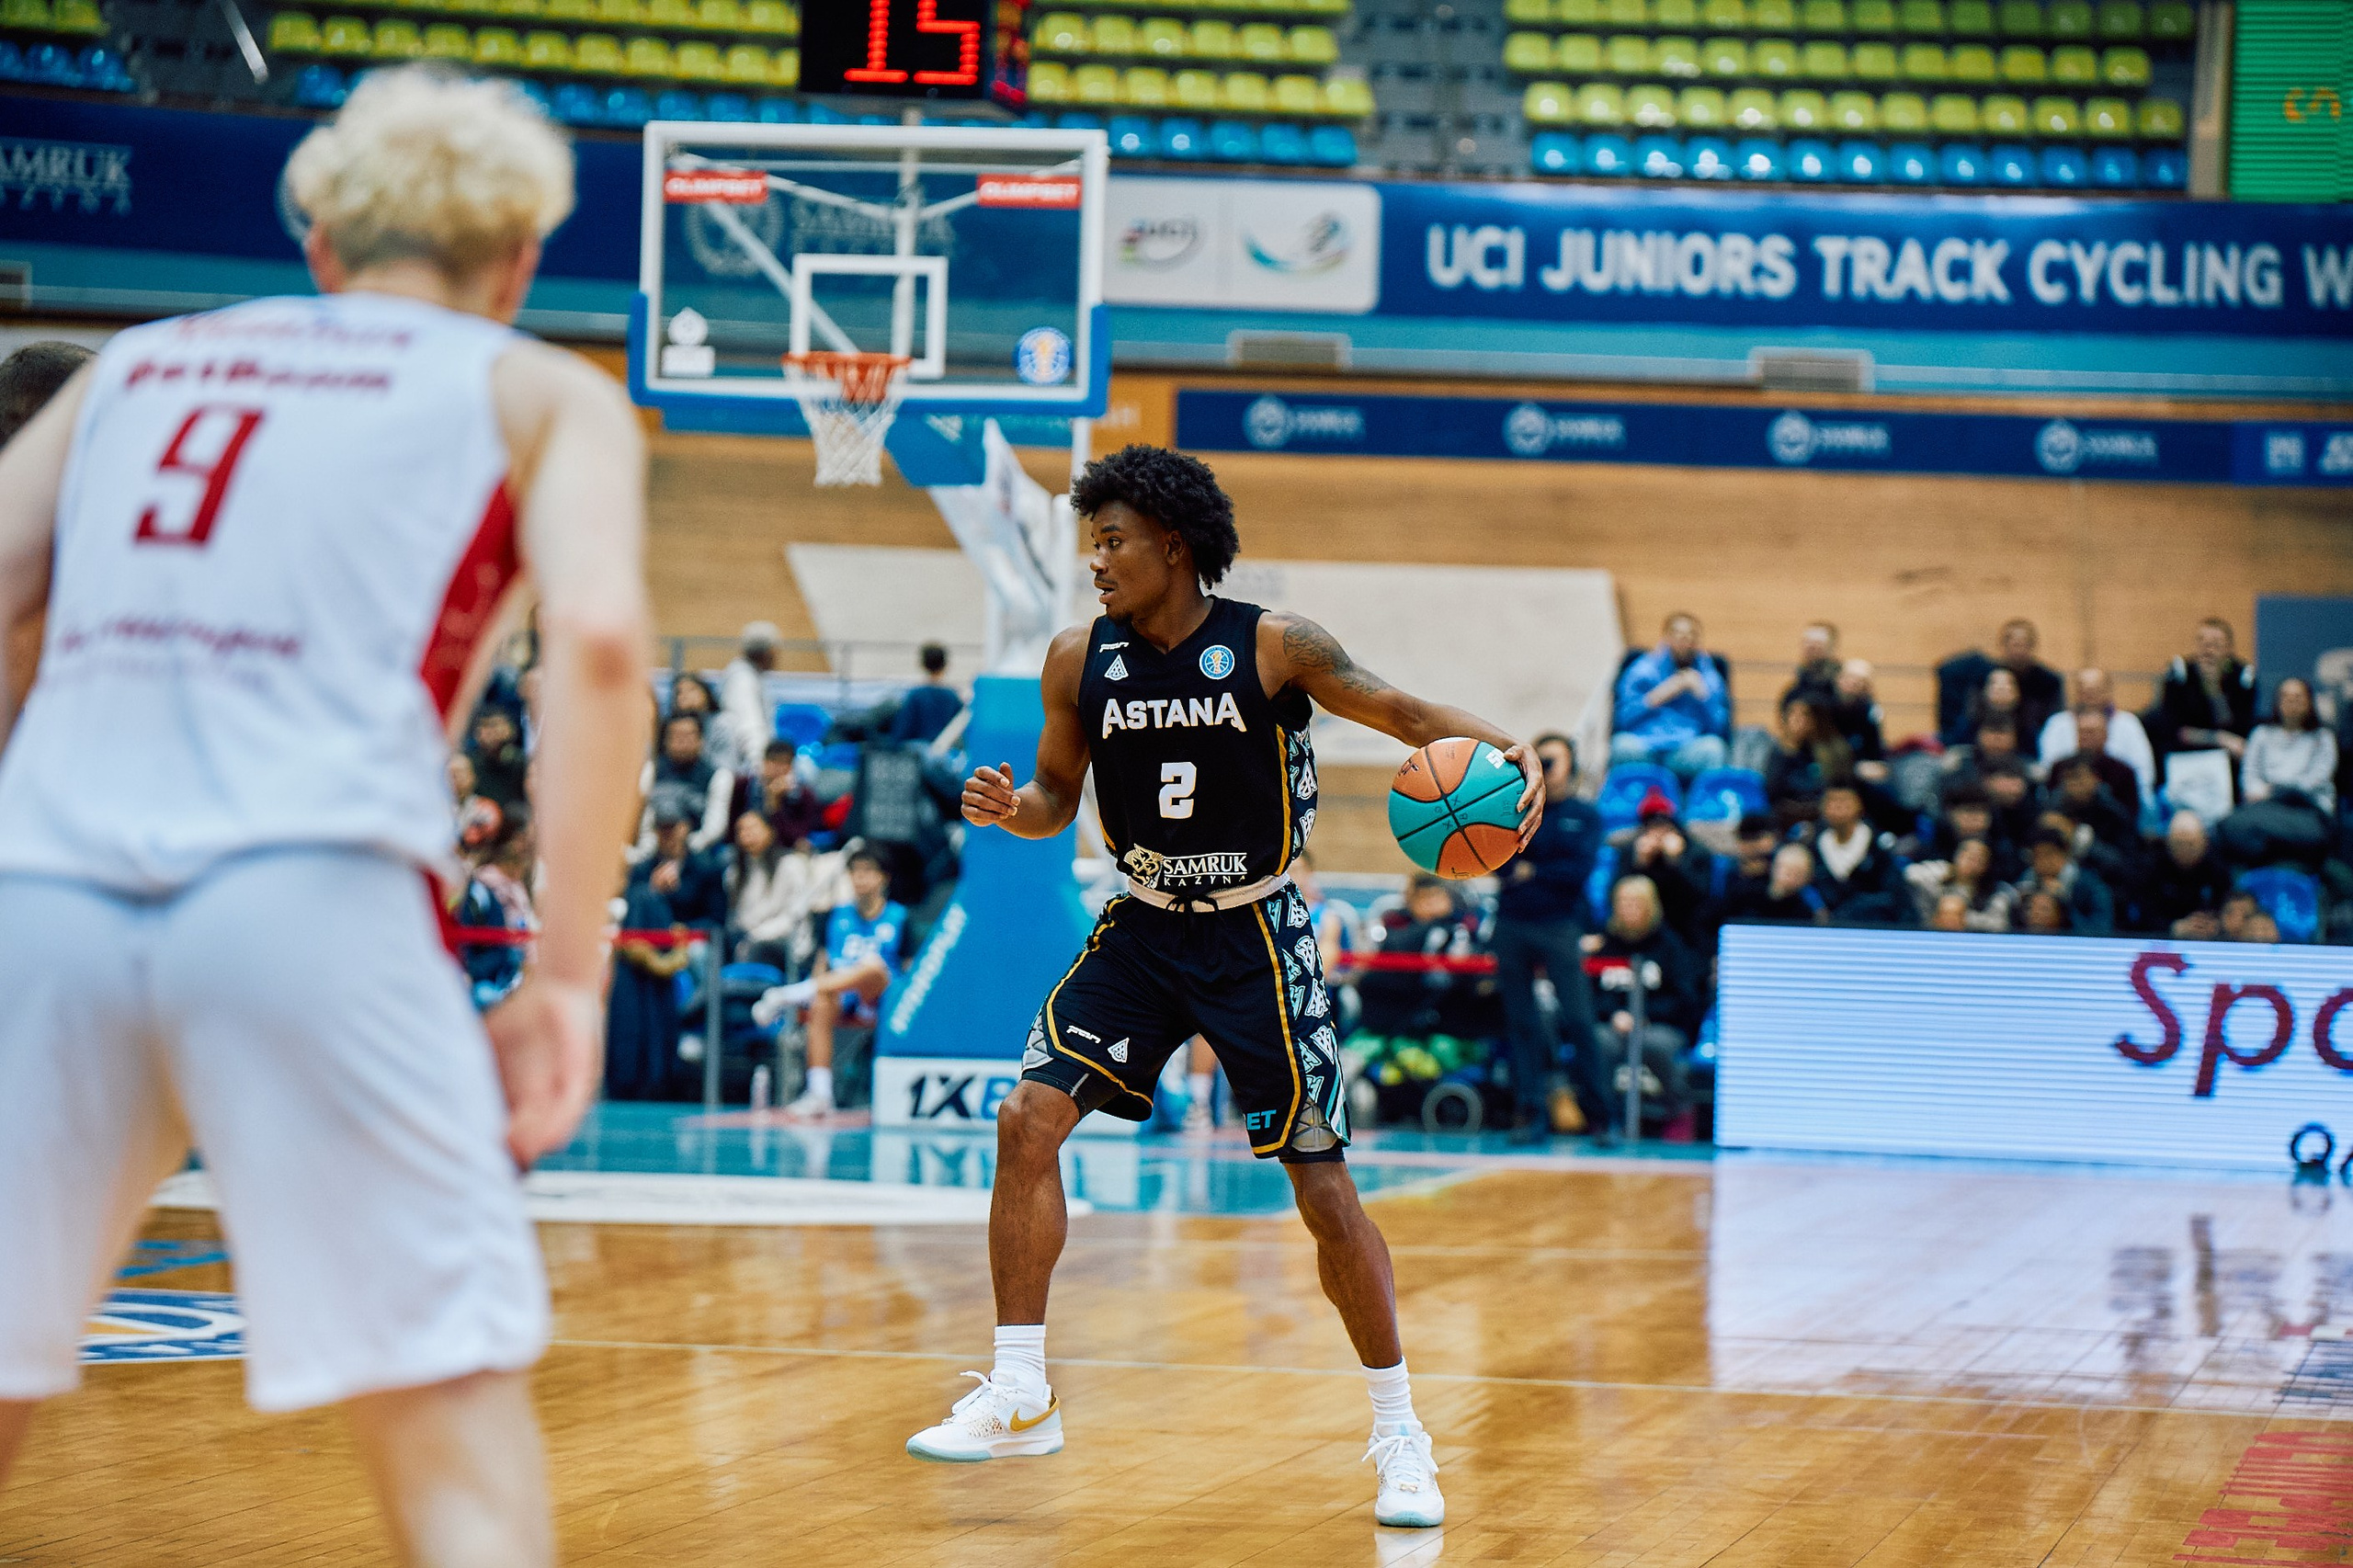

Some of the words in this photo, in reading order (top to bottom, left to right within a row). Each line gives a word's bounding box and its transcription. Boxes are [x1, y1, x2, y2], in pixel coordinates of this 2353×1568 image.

[844, 0, 981, 85] 15
[1426, 222, 1526, 291] UCI
[1539, 230, 1798, 299] JUNIORS
[1812, 234, 2012, 304] TRACK
[2028, 238, 2283, 308] CYCLING
[131, 403, 266, 547] 9
[1102, 691, 1248, 740] ASTANA
[1158, 761, 1197, 820] 2
[1163, 855, 1248, 875] SAMRUK
[910, 1074, 1018, 1120] 1XB
[1246, 1108, 1278, 1131] ET
